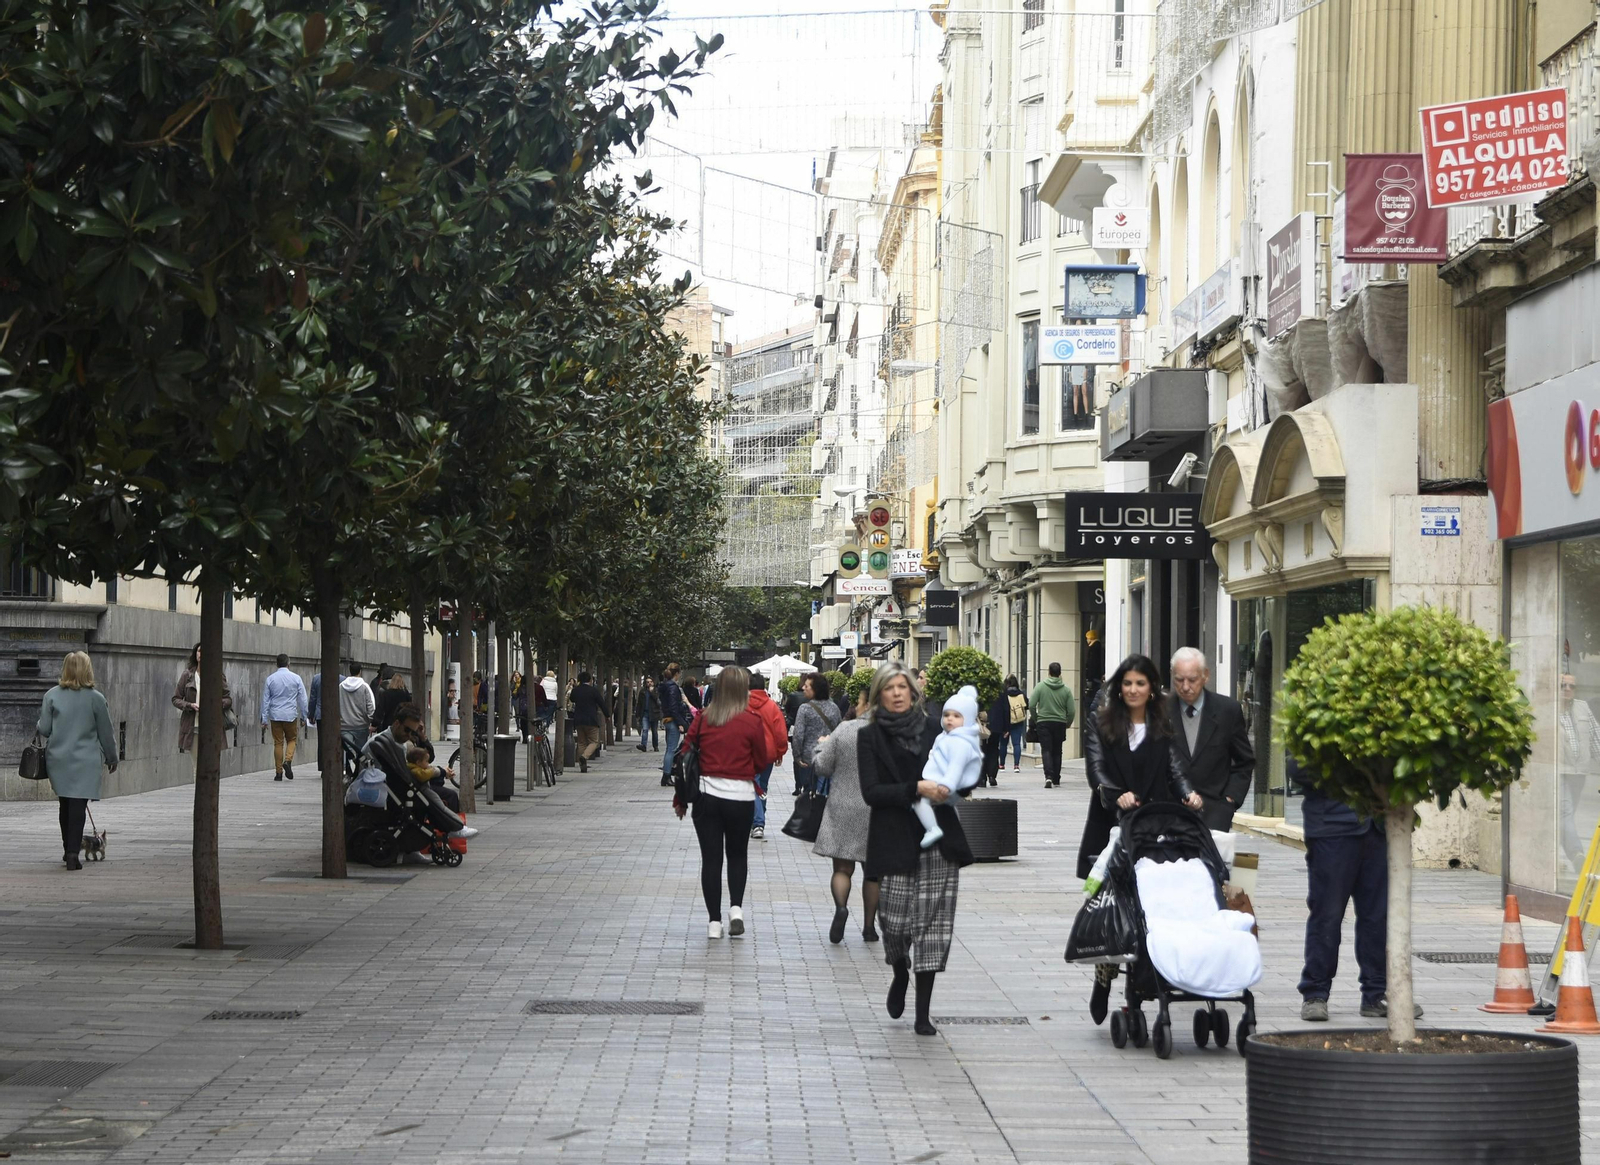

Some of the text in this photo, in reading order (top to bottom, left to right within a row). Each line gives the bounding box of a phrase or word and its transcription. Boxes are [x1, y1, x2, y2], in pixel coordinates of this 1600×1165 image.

[1470, 101, 1564, 131] redpiso
[1472, 121, 1565, 142] Servicios Inmobiliarios
[1438, 132, 1564, 168] ALQUILA
[1435, 155, 1570, 194] 957 244 023
[1511, 181, 1548, 192] CÓRDOBA
[1381, 194, 1410, 204] Doyslan
[1098, 226, 1141, 242] Europea
[873, 510, 886, 521] SE
[1080, 507, 1193, 527] LUQUE
[872, 534, 886, 544] NE
[1080, 533, 1193, 545] joyeros
[873, 553, 887, 566] CA
[842, 581, 887, 592] Seneca
[1094, 588, 1106, 604] S
